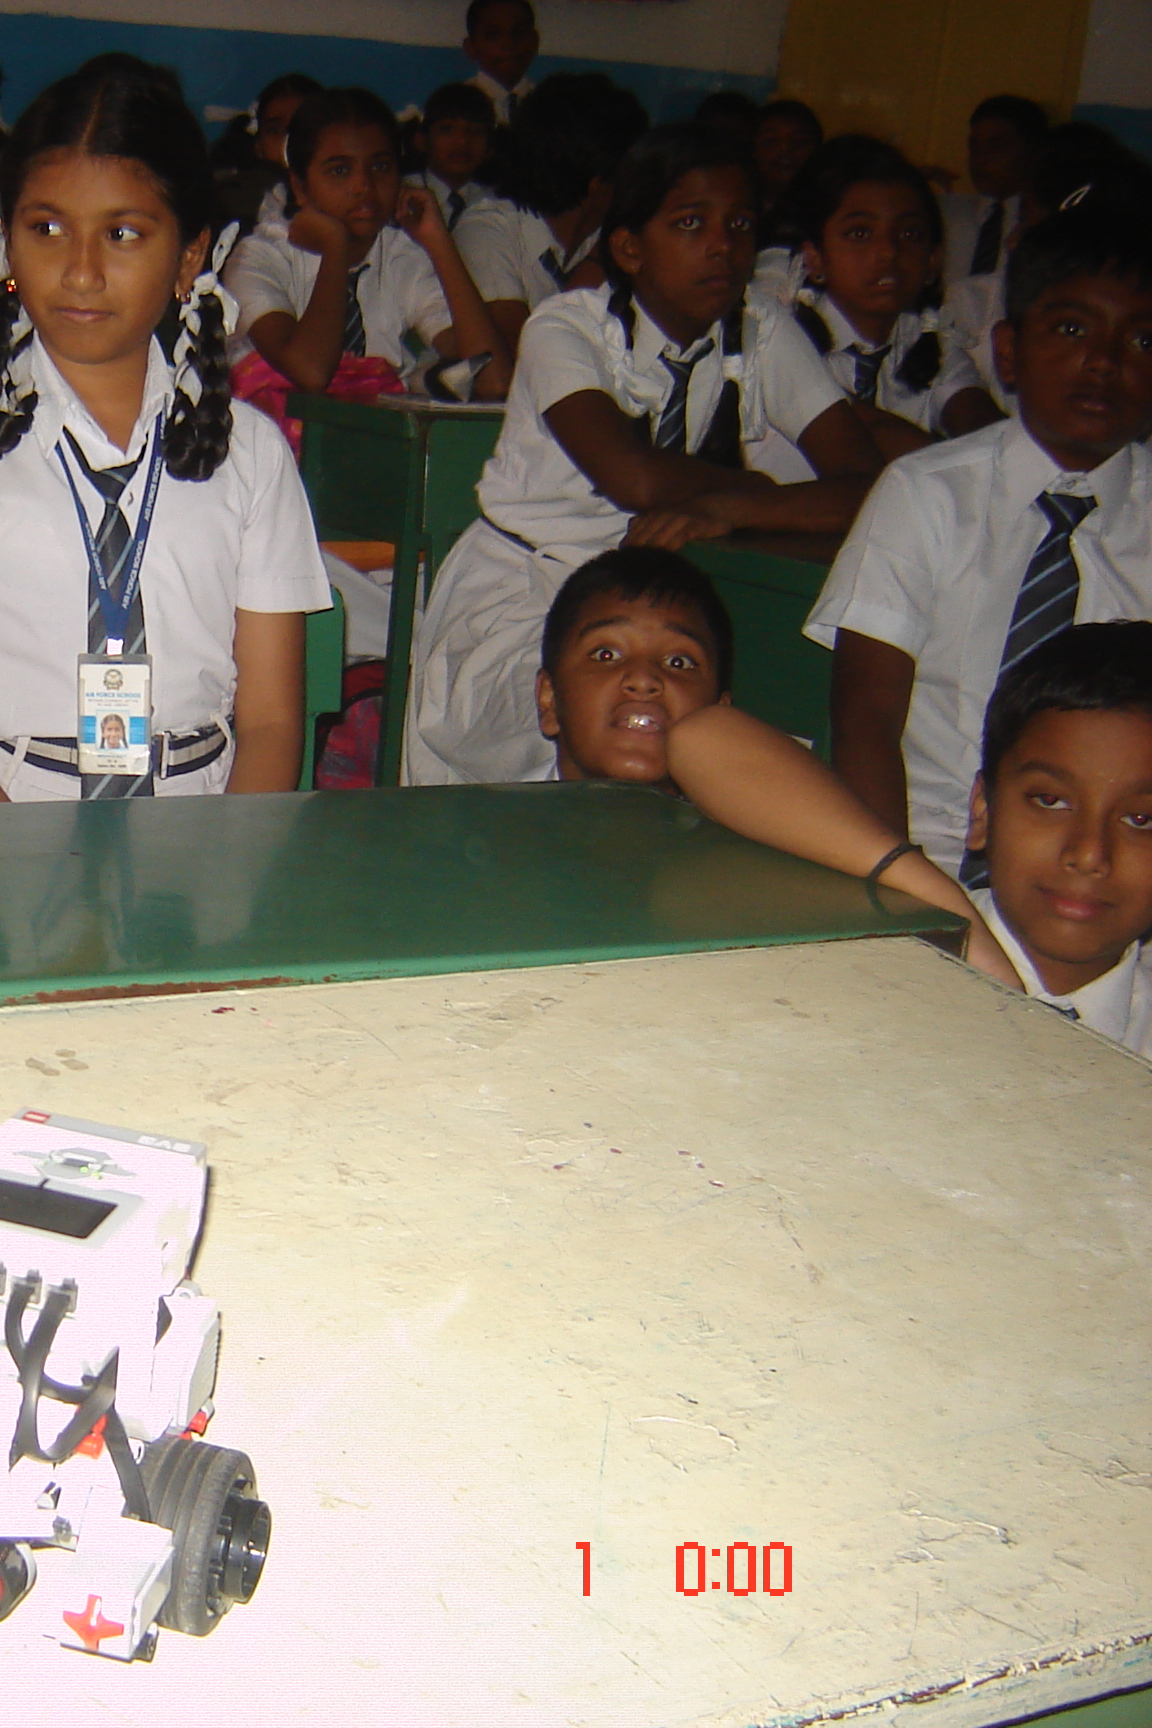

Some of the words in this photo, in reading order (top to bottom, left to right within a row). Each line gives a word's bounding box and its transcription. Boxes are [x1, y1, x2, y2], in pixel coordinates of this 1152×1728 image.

[121, 595, 131, 609] AIR
[127, 569, 138, 595] FORCE
[133, 539, 145, 569] SCHOOL
